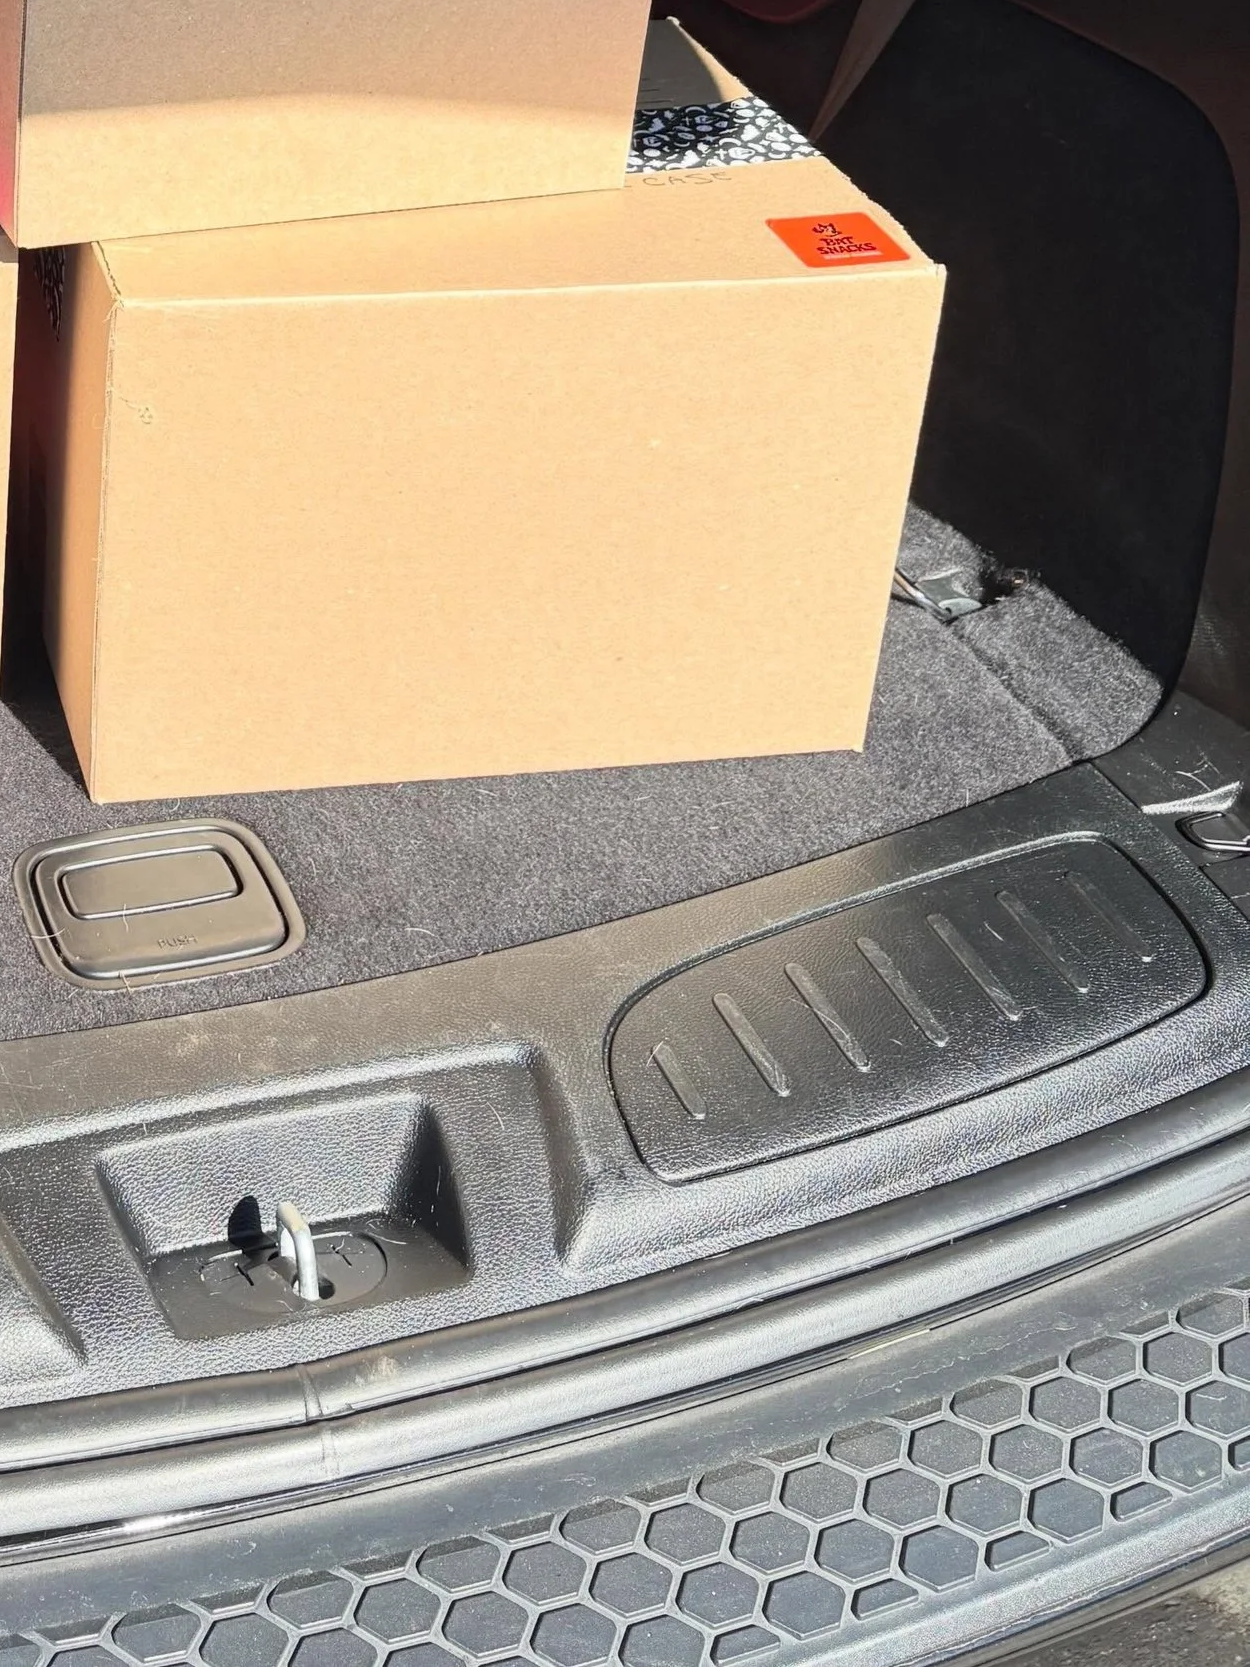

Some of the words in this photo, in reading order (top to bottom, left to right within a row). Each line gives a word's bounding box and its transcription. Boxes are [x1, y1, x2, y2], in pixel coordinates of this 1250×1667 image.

[642, 171, 732, 187] CASE
[819, 236, 854, 246] BAT
[816, 242, 877, 255] SNACKS
[156, 934, 198, 949] PUSH
